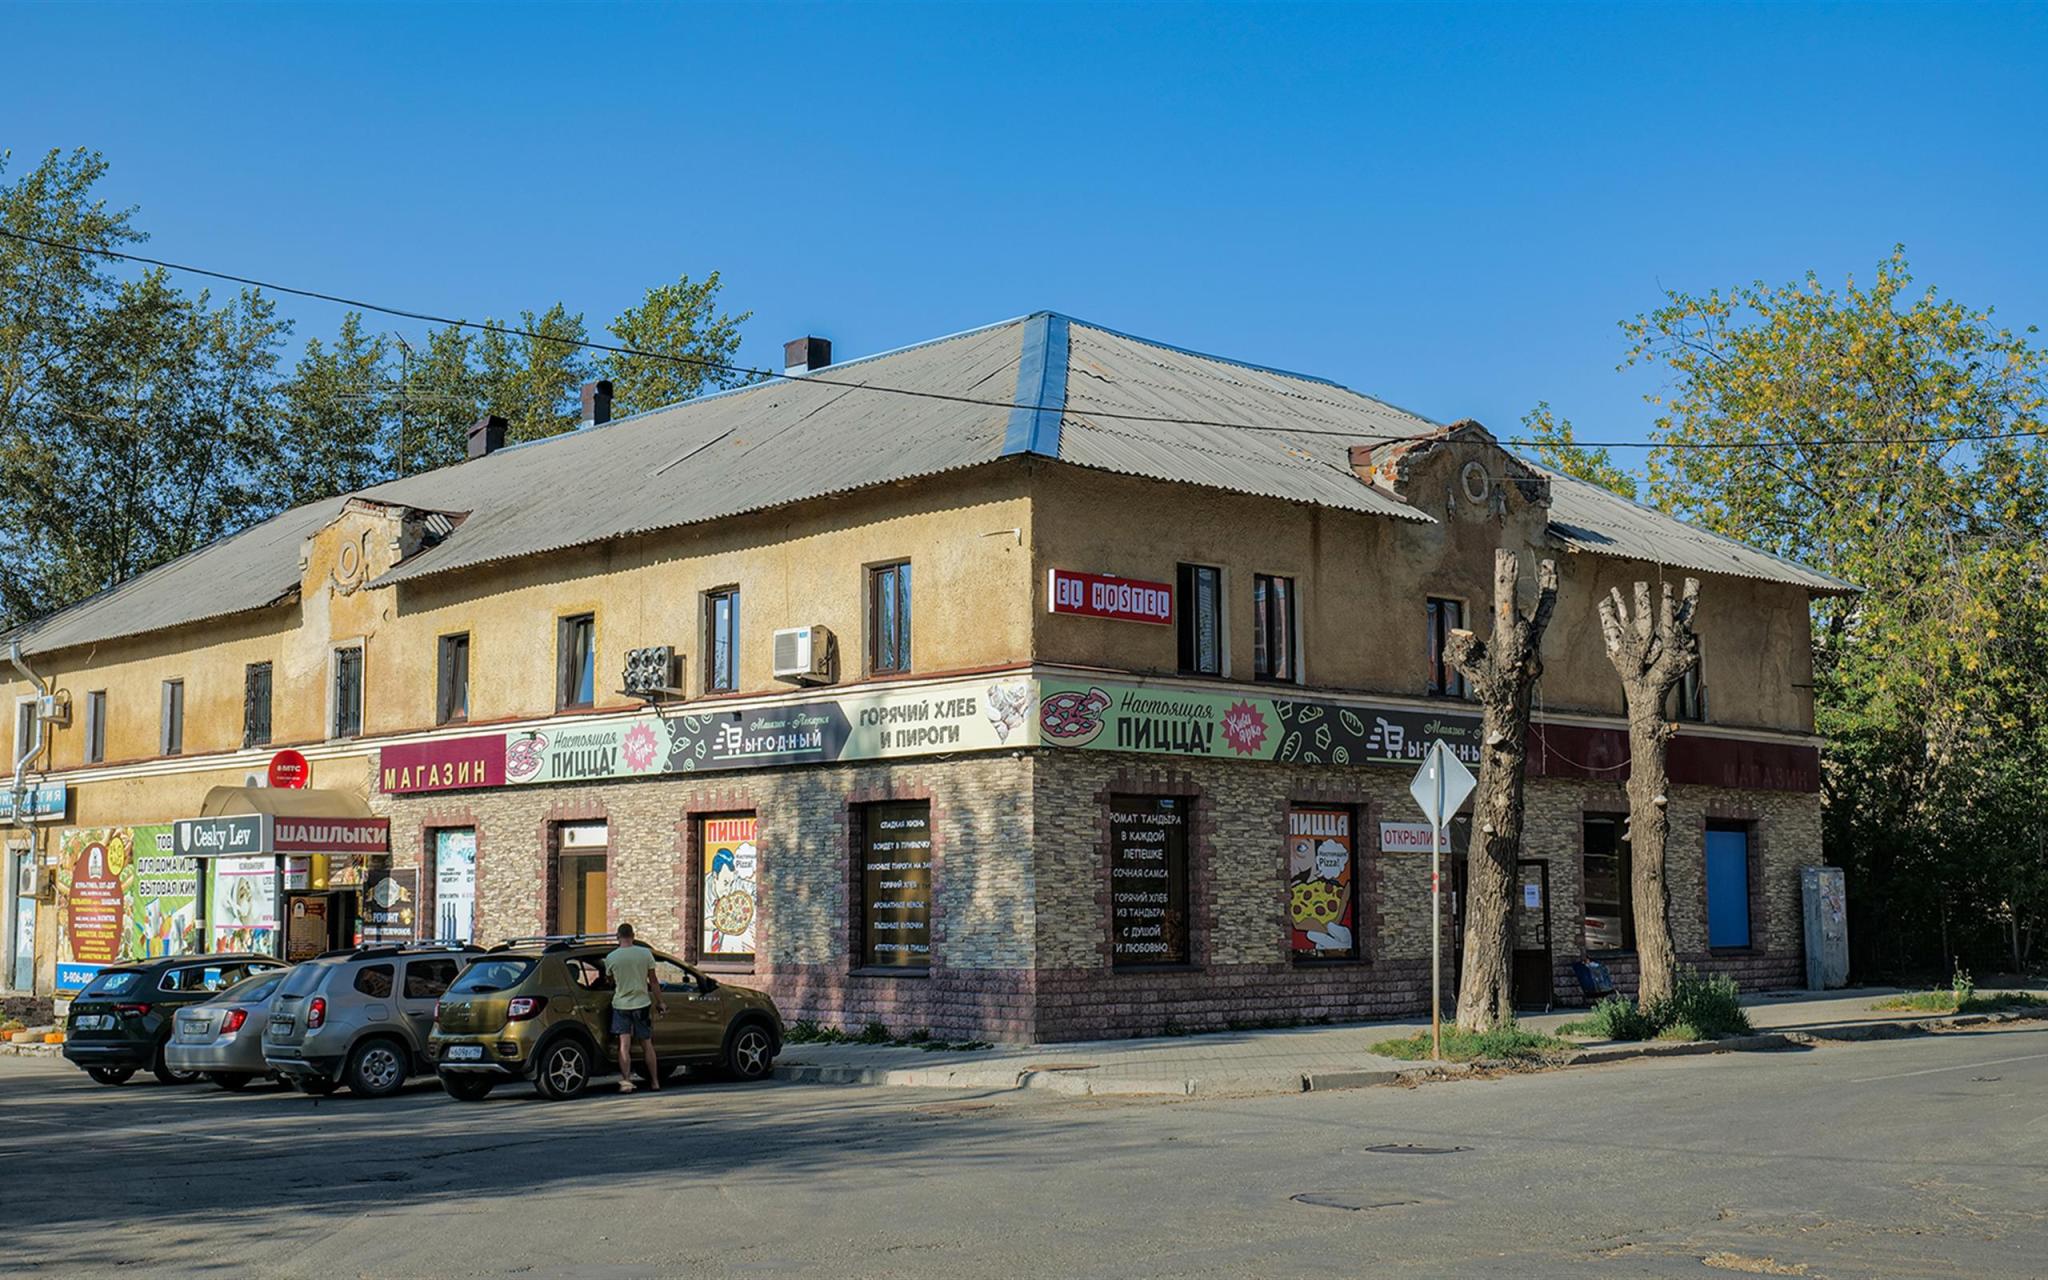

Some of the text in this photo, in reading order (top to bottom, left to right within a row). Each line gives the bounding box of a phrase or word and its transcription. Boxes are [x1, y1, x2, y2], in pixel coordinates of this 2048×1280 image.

[1057, 579, 1170, 619] EL HOSTEL
[859, 697, 977, 727] ГОРЯЧИЙ ХЛЕБ
[1120, 691, 1215, 723] Настоящая
[554, 731, 617, 751] Настоящая
[881, 725, 960, 749] И ПИРОГИ
[1117, 717, 1214, 753] ПИЦЦА!
[552, 747, 617, 778] ПИЦЦА!
[384, 760, 486, 790] МАГАЗИН
[1141, 814, 1182, 825] ТАНДЫРА
[1289, 814, 1348, 836] ПИЦЦА
[194, 824, 251, 850] Cesky Lev
[276, 824, 387, 844] ШАШЛЫКИ
[1121, 830, 1165, 843] В КАЖДОЙ
[1384, 830, 1447, 845] ОТКРЫЛИЬ
[1123, 849, 1163, 860] ЛЕПЕШКЕ
[138, 859, 153, 873] ДЛЯ
[155, 858, 176, 871] ДОМА
[180, 858, 186, 870] И
[1319, 857, 1341, 868] Pizza!
[1113, 868, 1169, 878] СОЧНАЯ САМСА
[140, 882, 177, 896] БЫТОВАЯ
[1114, 891, 1169, 903] ГОРЯЧИЙ ХЛЕБ
[1117, 907, 1165, 918] ИЗ ТАНДЫРА
[1123, 924, 1161, 938] С ДУШОЙ
[1116, 942, 1168, 953] И ЛЮБОВЬЮ
